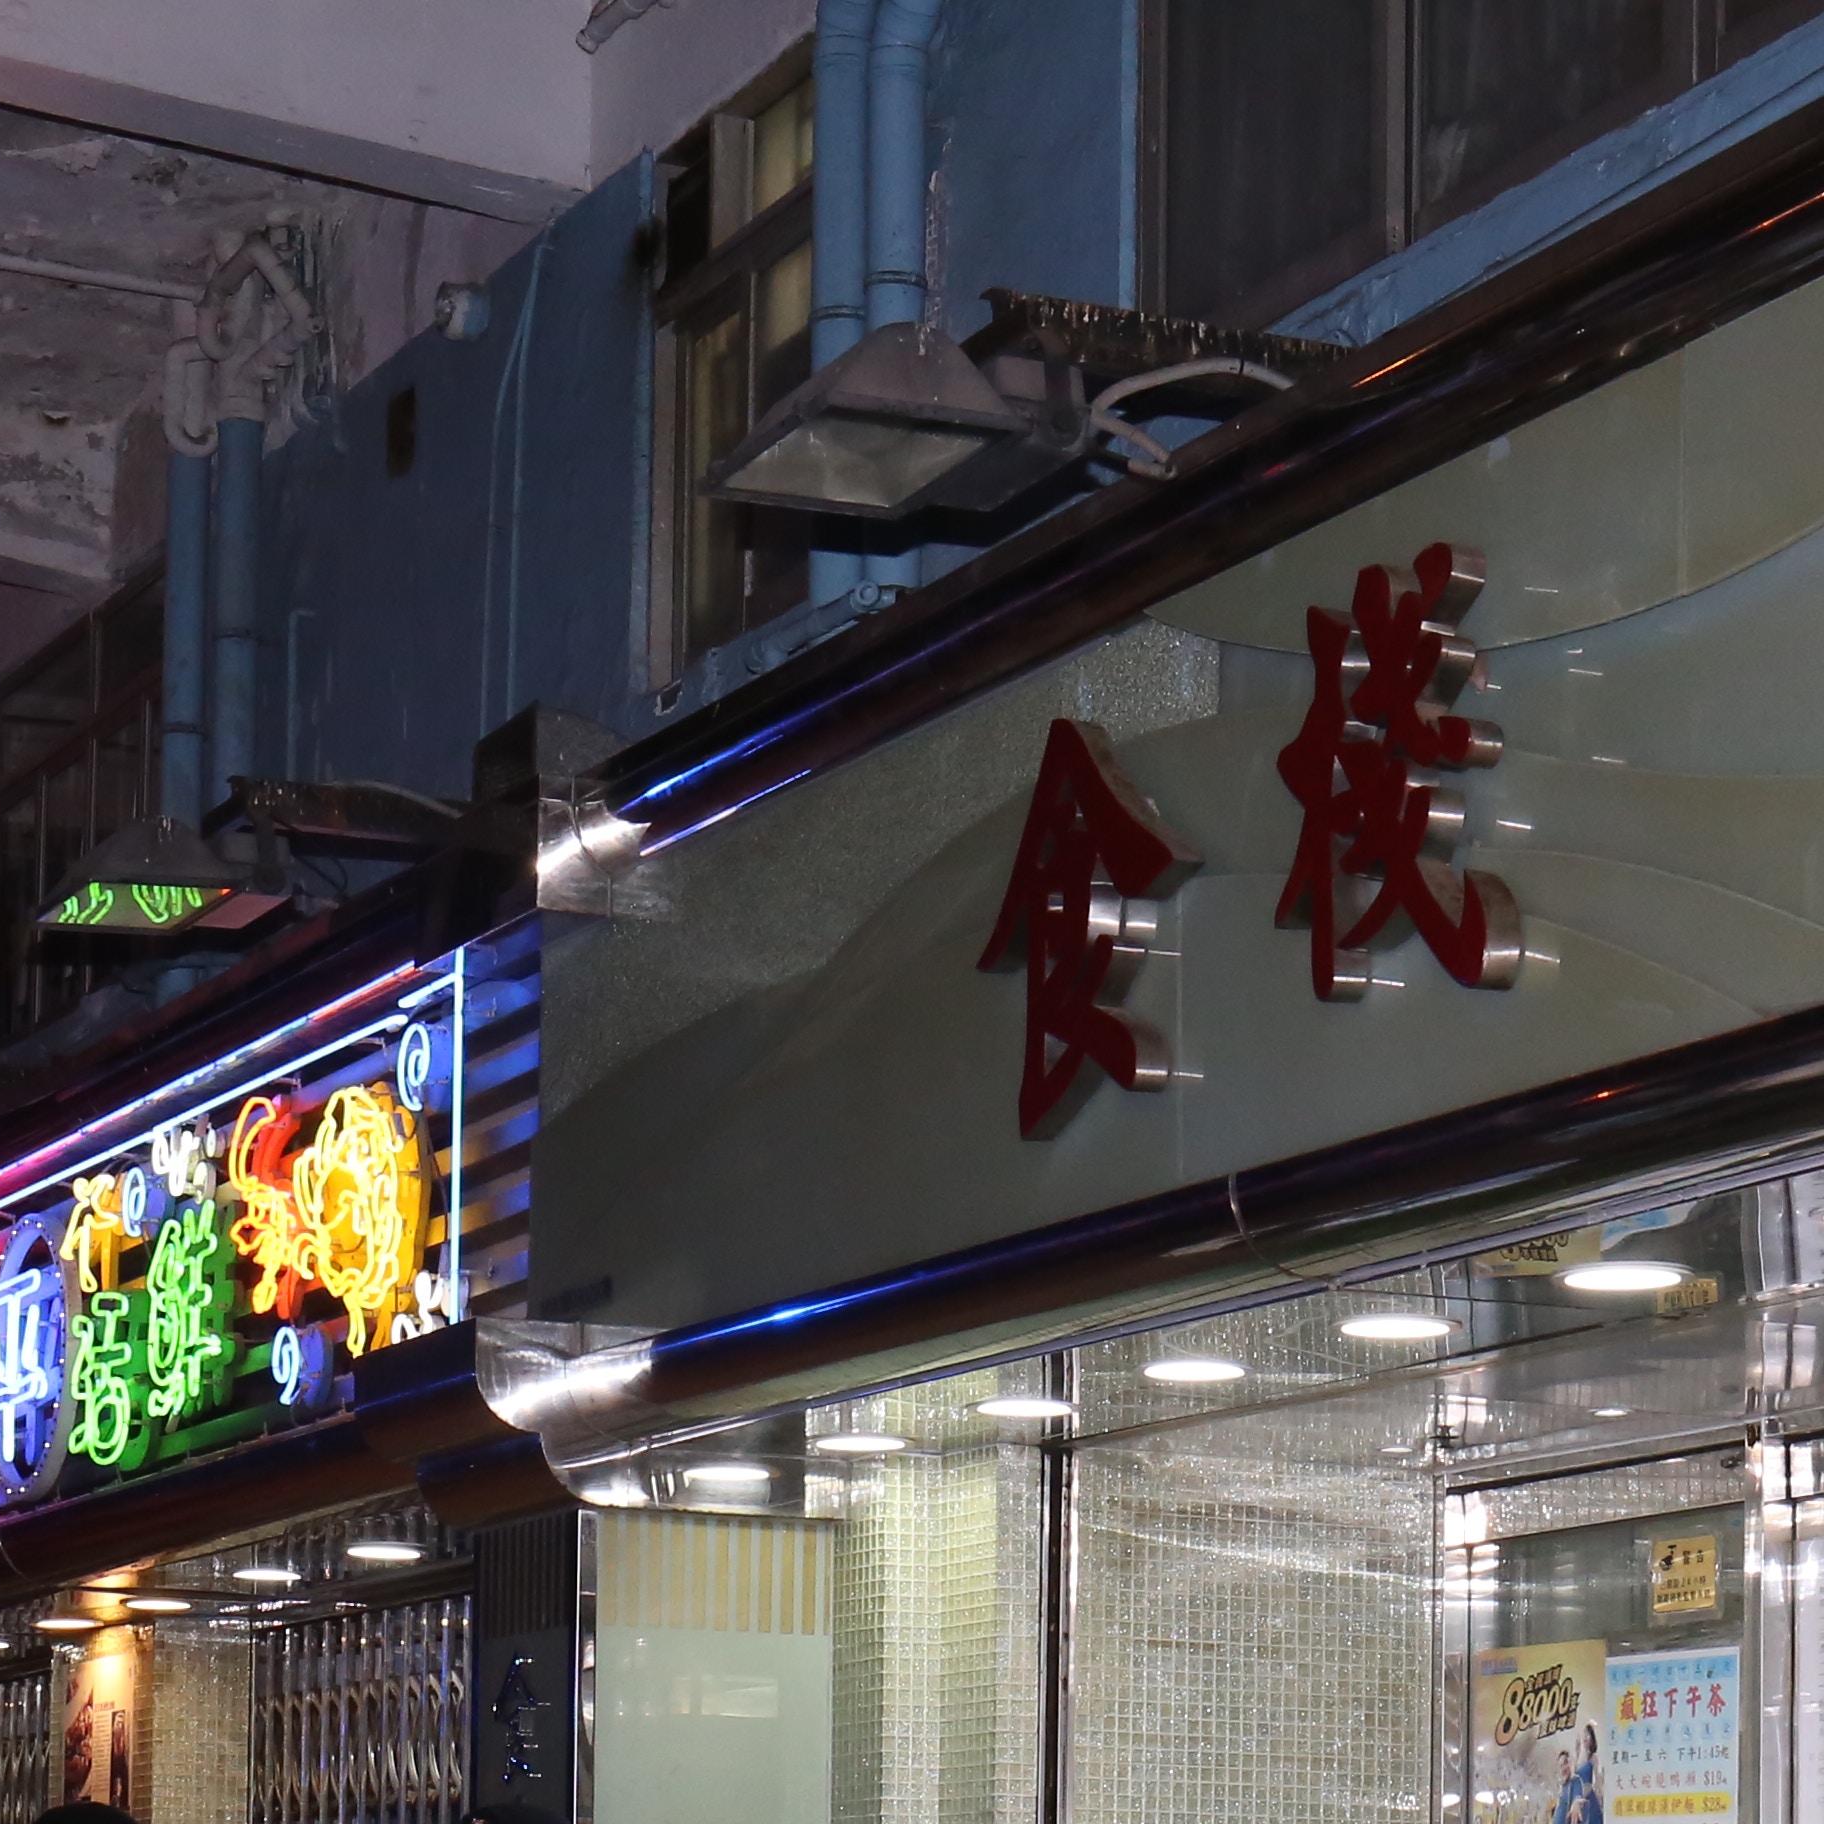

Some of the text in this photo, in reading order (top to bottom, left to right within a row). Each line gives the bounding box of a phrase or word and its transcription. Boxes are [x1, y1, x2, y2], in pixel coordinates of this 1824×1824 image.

[1620, 1684, 1725, 1721] 瘋狂下午茶
